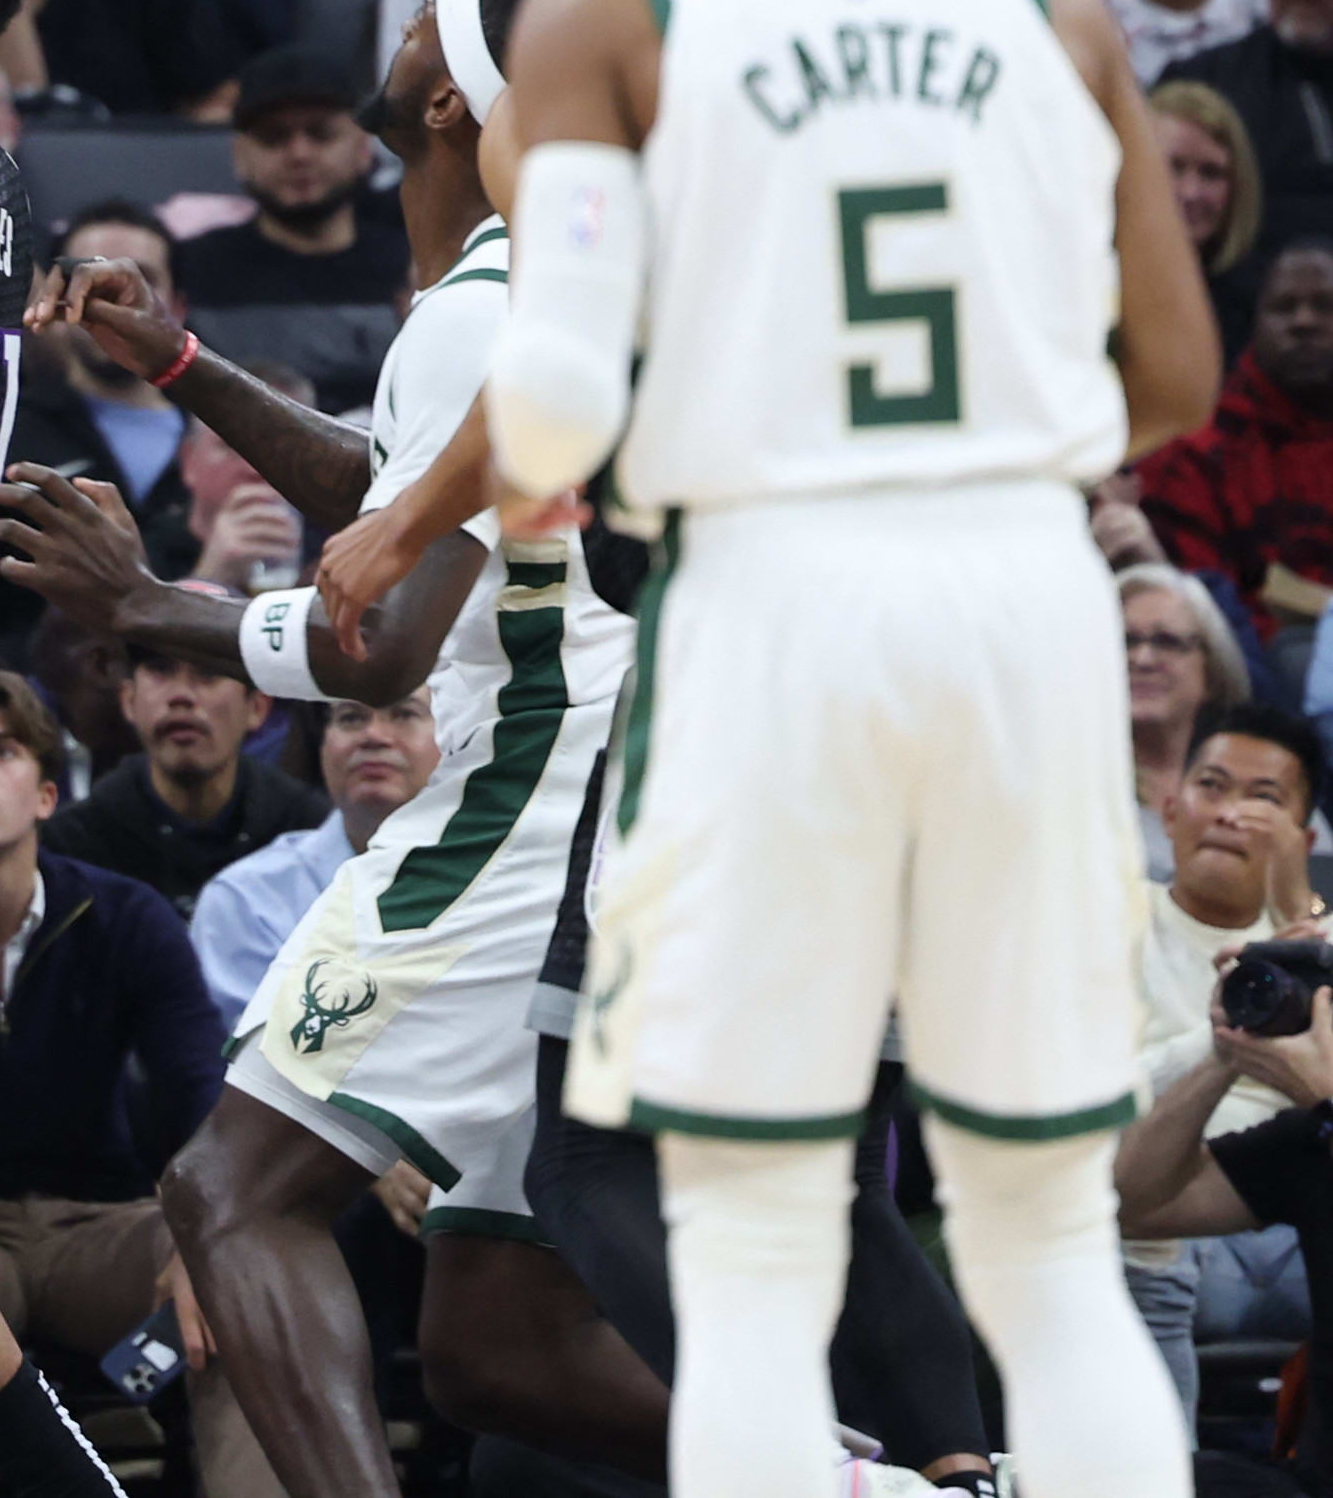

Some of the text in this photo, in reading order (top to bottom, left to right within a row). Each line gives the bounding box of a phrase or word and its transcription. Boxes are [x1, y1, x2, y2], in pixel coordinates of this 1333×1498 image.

[741, 20, 1001, 136] CARTER
[837, 181, 962, 429] 5
[261, 603, 291, 652] BP
